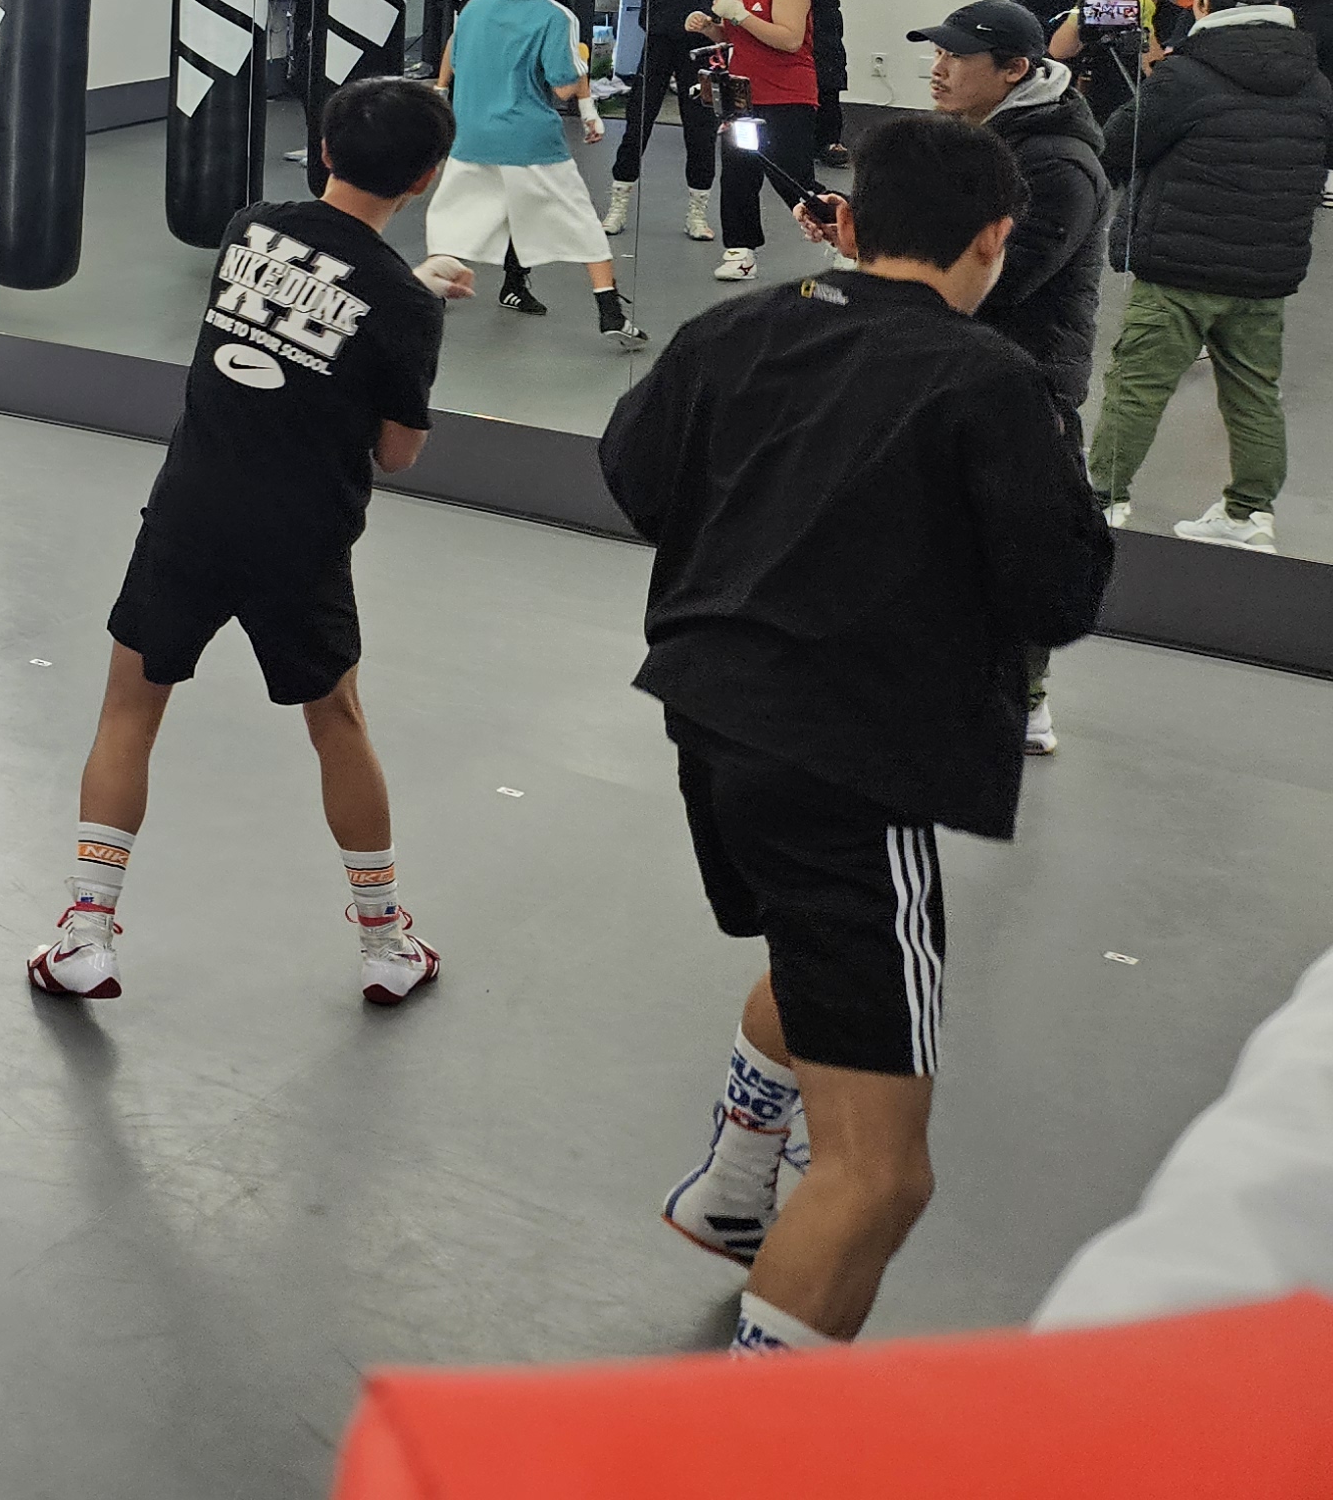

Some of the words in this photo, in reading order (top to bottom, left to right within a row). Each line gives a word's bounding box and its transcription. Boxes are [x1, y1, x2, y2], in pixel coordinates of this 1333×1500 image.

[219, 246, 285, 297] NIKE
[279, 266, 366, 335] DUNK
[248, 327, 282, 353] YOUR
[83, 845, 128, 863] NIK
